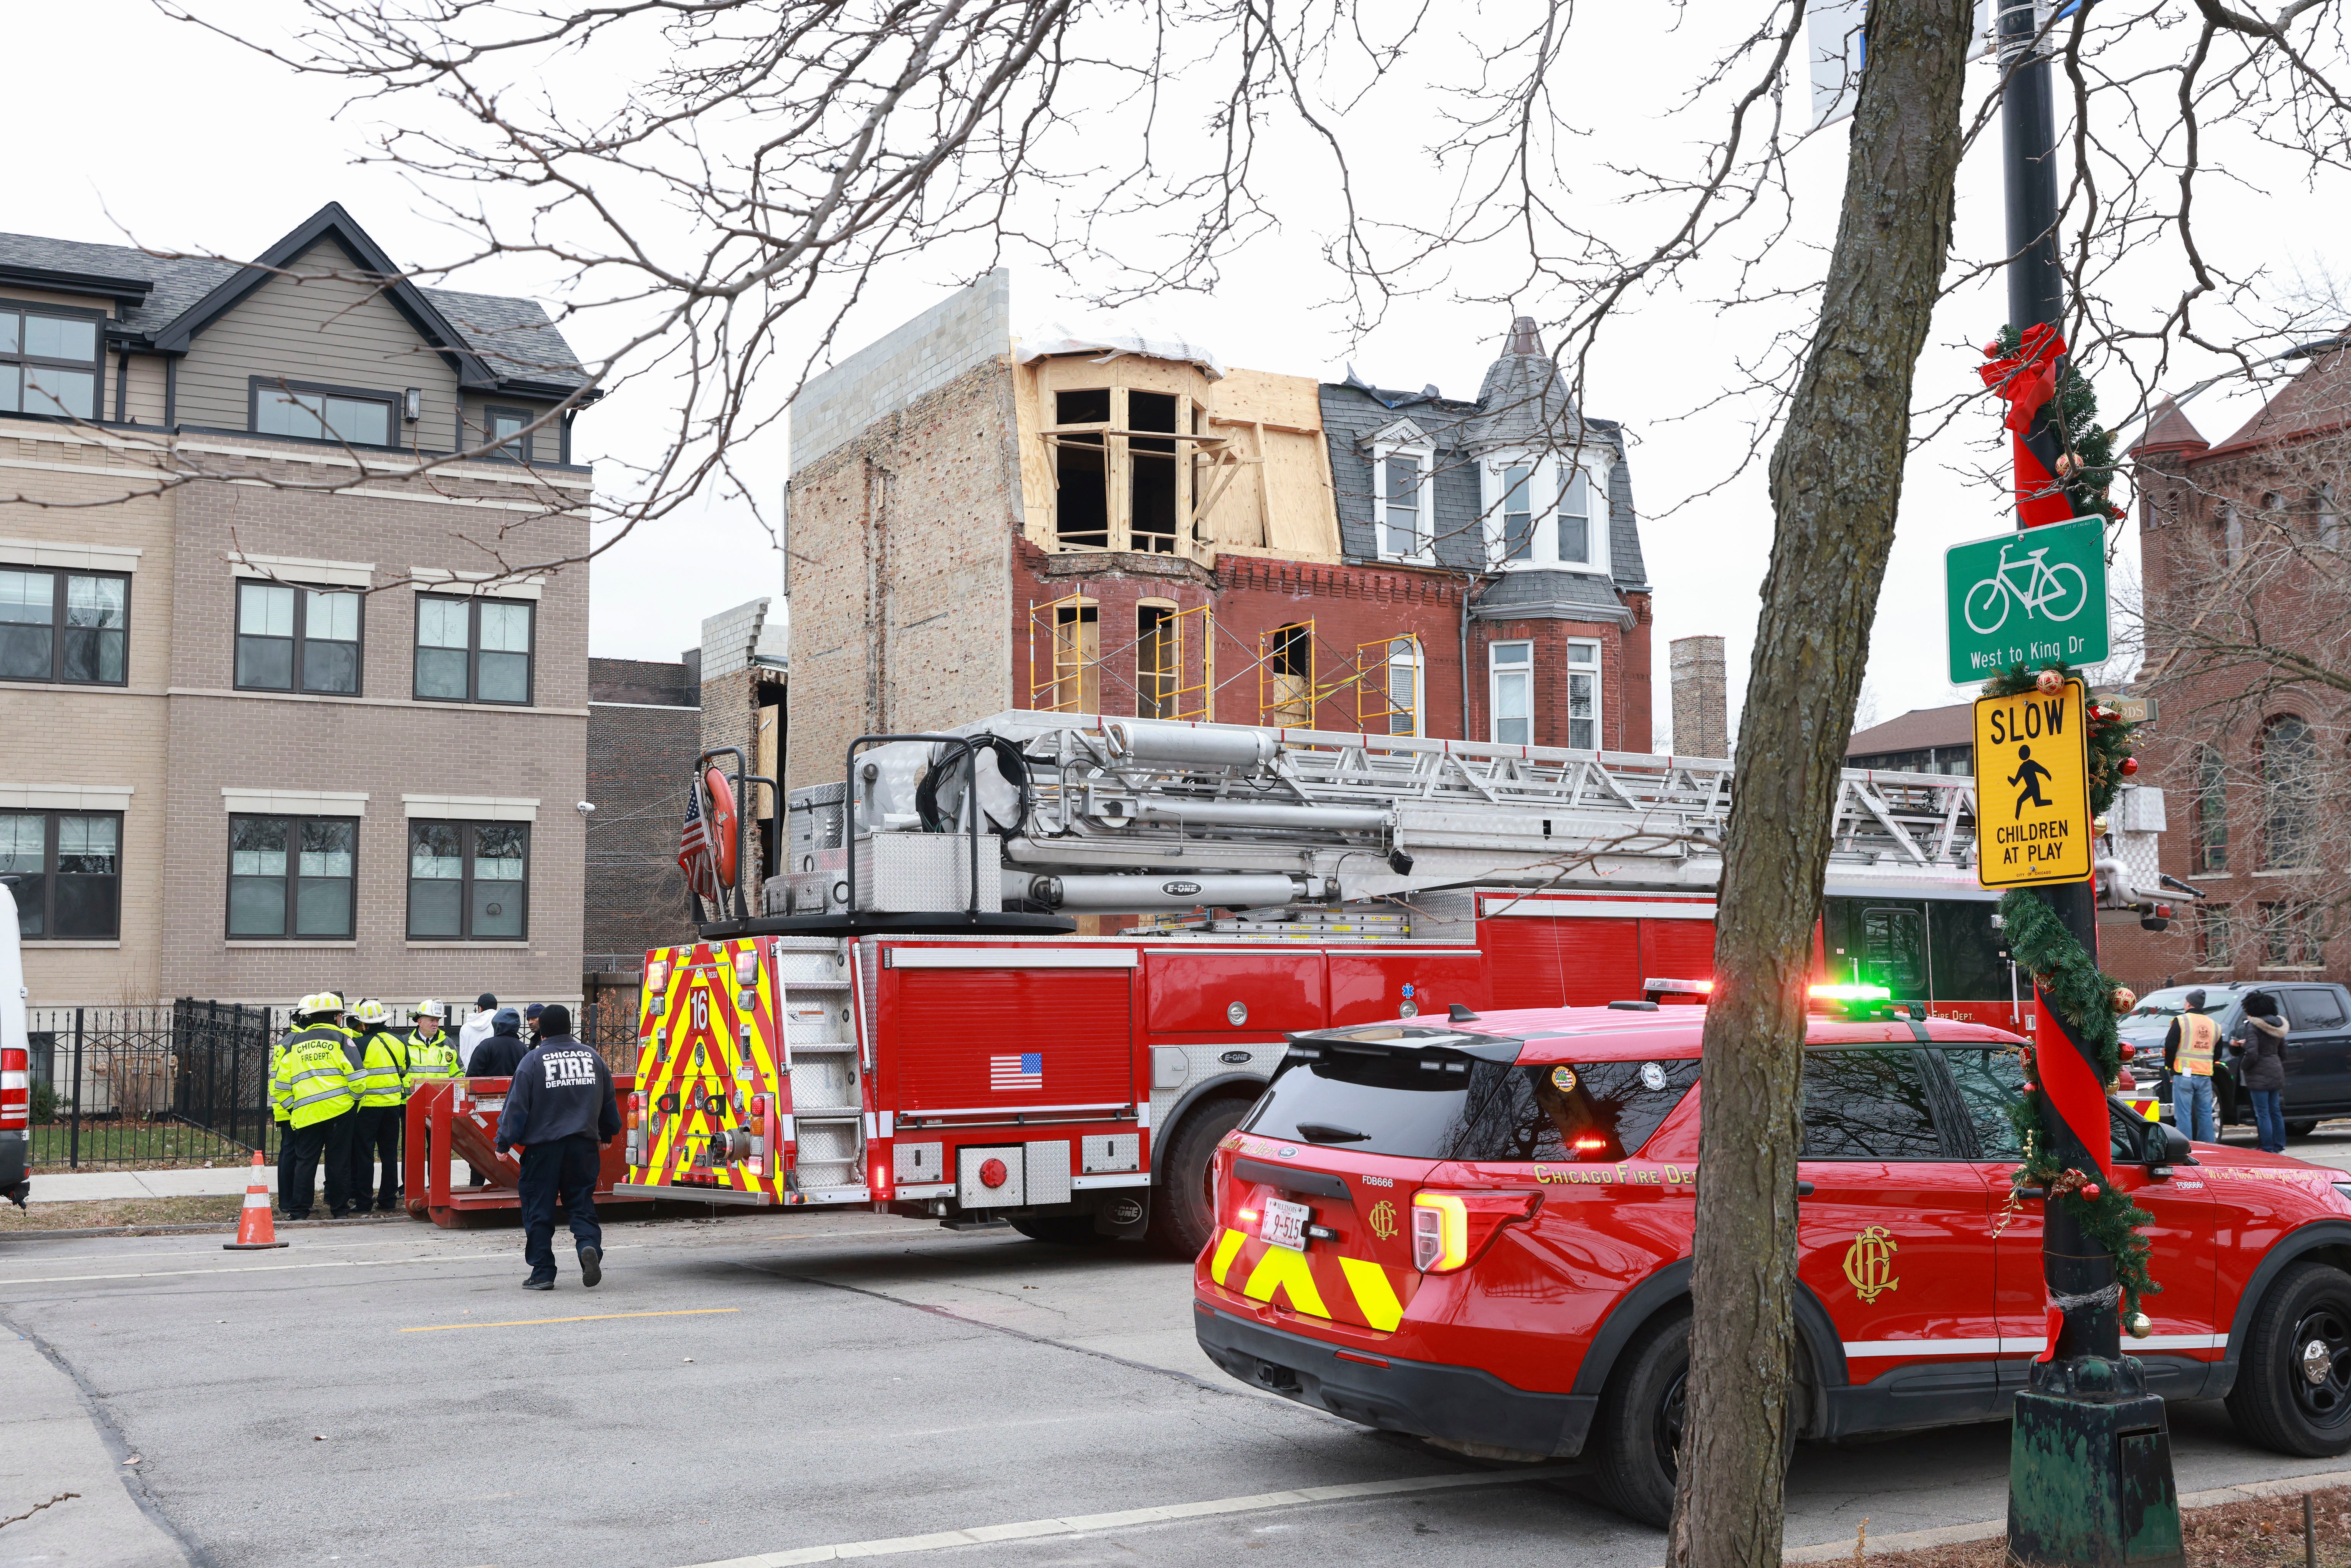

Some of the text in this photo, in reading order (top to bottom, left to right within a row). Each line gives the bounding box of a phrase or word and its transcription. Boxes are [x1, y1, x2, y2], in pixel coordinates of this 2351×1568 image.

[1053, 323, 1074, 336] EVERBILT
[1970, 636, 2084, 669] West to King Dr
[1991, 698, 2064, 745] SLOW
[1997, 820, 2068, 844] CHILDREN
[2003, 842, 2063, 864] AT PLAY
[1167, 884, 1197, 892] E-ONE
[707, 971, 718, 979] FDE353
[691, 990, 708, 1030] 16
[1952, 1010, 1975, 1020] DEPT.
[297, 1041, 334, 1053] CHICAGO
[301, 1052, 331, 1063] FIRE DEPT.
[542, 1051, 592, 1060] CHICAGO
[543, 1057, 595, 1081] FIRE
[545, 1078, 596, 1088] DEPARTMENT
[1234, 1137, 1254, 1154] FIRE
[1252, 1140, 1277, 1158] DEPT.
[1533, 1164, 1613, 1184] CHICAGO
[1614, 1164, 1661, 1184] FIRE
[2205, 1168, 2230, 1179] We're
[1362, 1175, 1393, 1187] FDB666
[1277, 1203, 1297, 1213] ILLINOIS
[1273, 1214, 1300, 1240] 9-515
